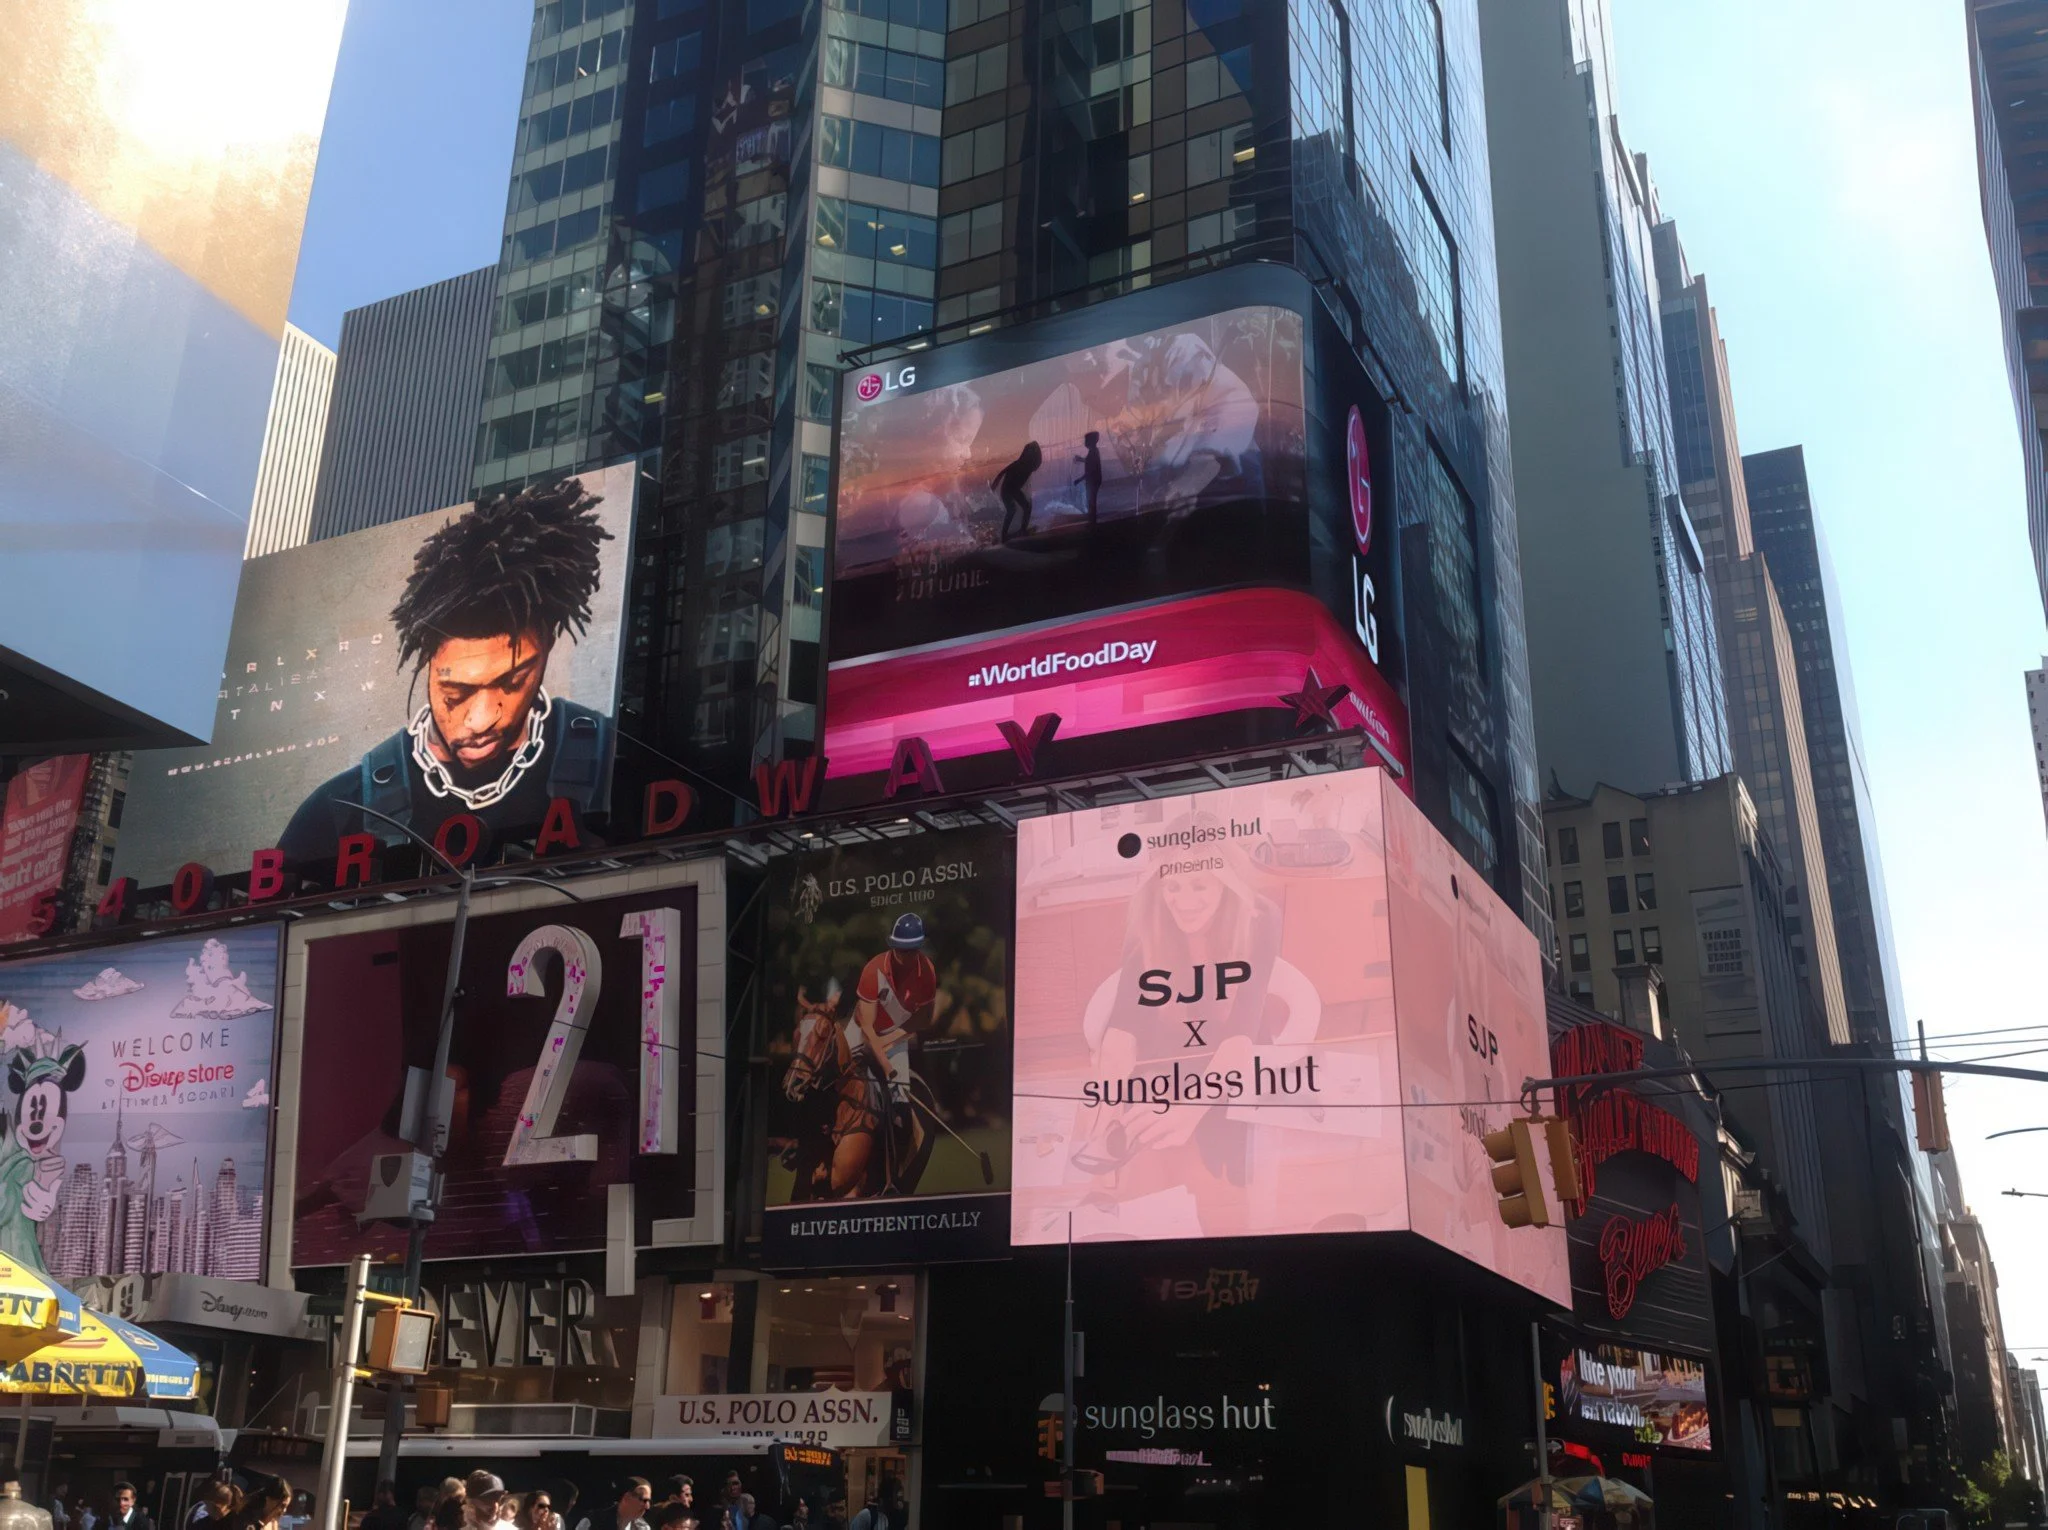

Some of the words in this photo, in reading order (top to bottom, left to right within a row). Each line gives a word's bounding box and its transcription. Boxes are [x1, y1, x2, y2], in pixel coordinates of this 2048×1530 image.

[884, 366, 916, 391] LG
[1352, 554, 1379, 665] LG
[968, 640, 1157, 688] #WorldFoodDay
[1146, 824, 1228, 851] sunglass
[828, 879, 859, 898] U.S.
[864, 871, 916, 893] POLO
[920, 861, 978, 885] ASSN.
[1138, 960, 1252, 1007] SJP
[112, 1027, 230, 1058] WELCOME
[502, 906, 681, 1167] 21
[1467, 1012, 1498, 1066] SJP
[119, 1062, 186, 1097] Disney
[188, 1063, 235, 1084] store
[1082, 1062, 1244, 1115] sunglass
[1253, 1055, 1321, 1096] hut
[790, 1211, 982, 1237] #LIVEAUTHENTICALLY
[1606, 1363, 1637, 1394] your
[679, 1401, 721, 1425] U.S.
[727, 1399, 797, 1425] POLO
[803, 1397, 879, 1424] ASSN.
[1085, 1395, 1214, 1439] sunglass
[1222, 1395, 1277, 1431] hut
